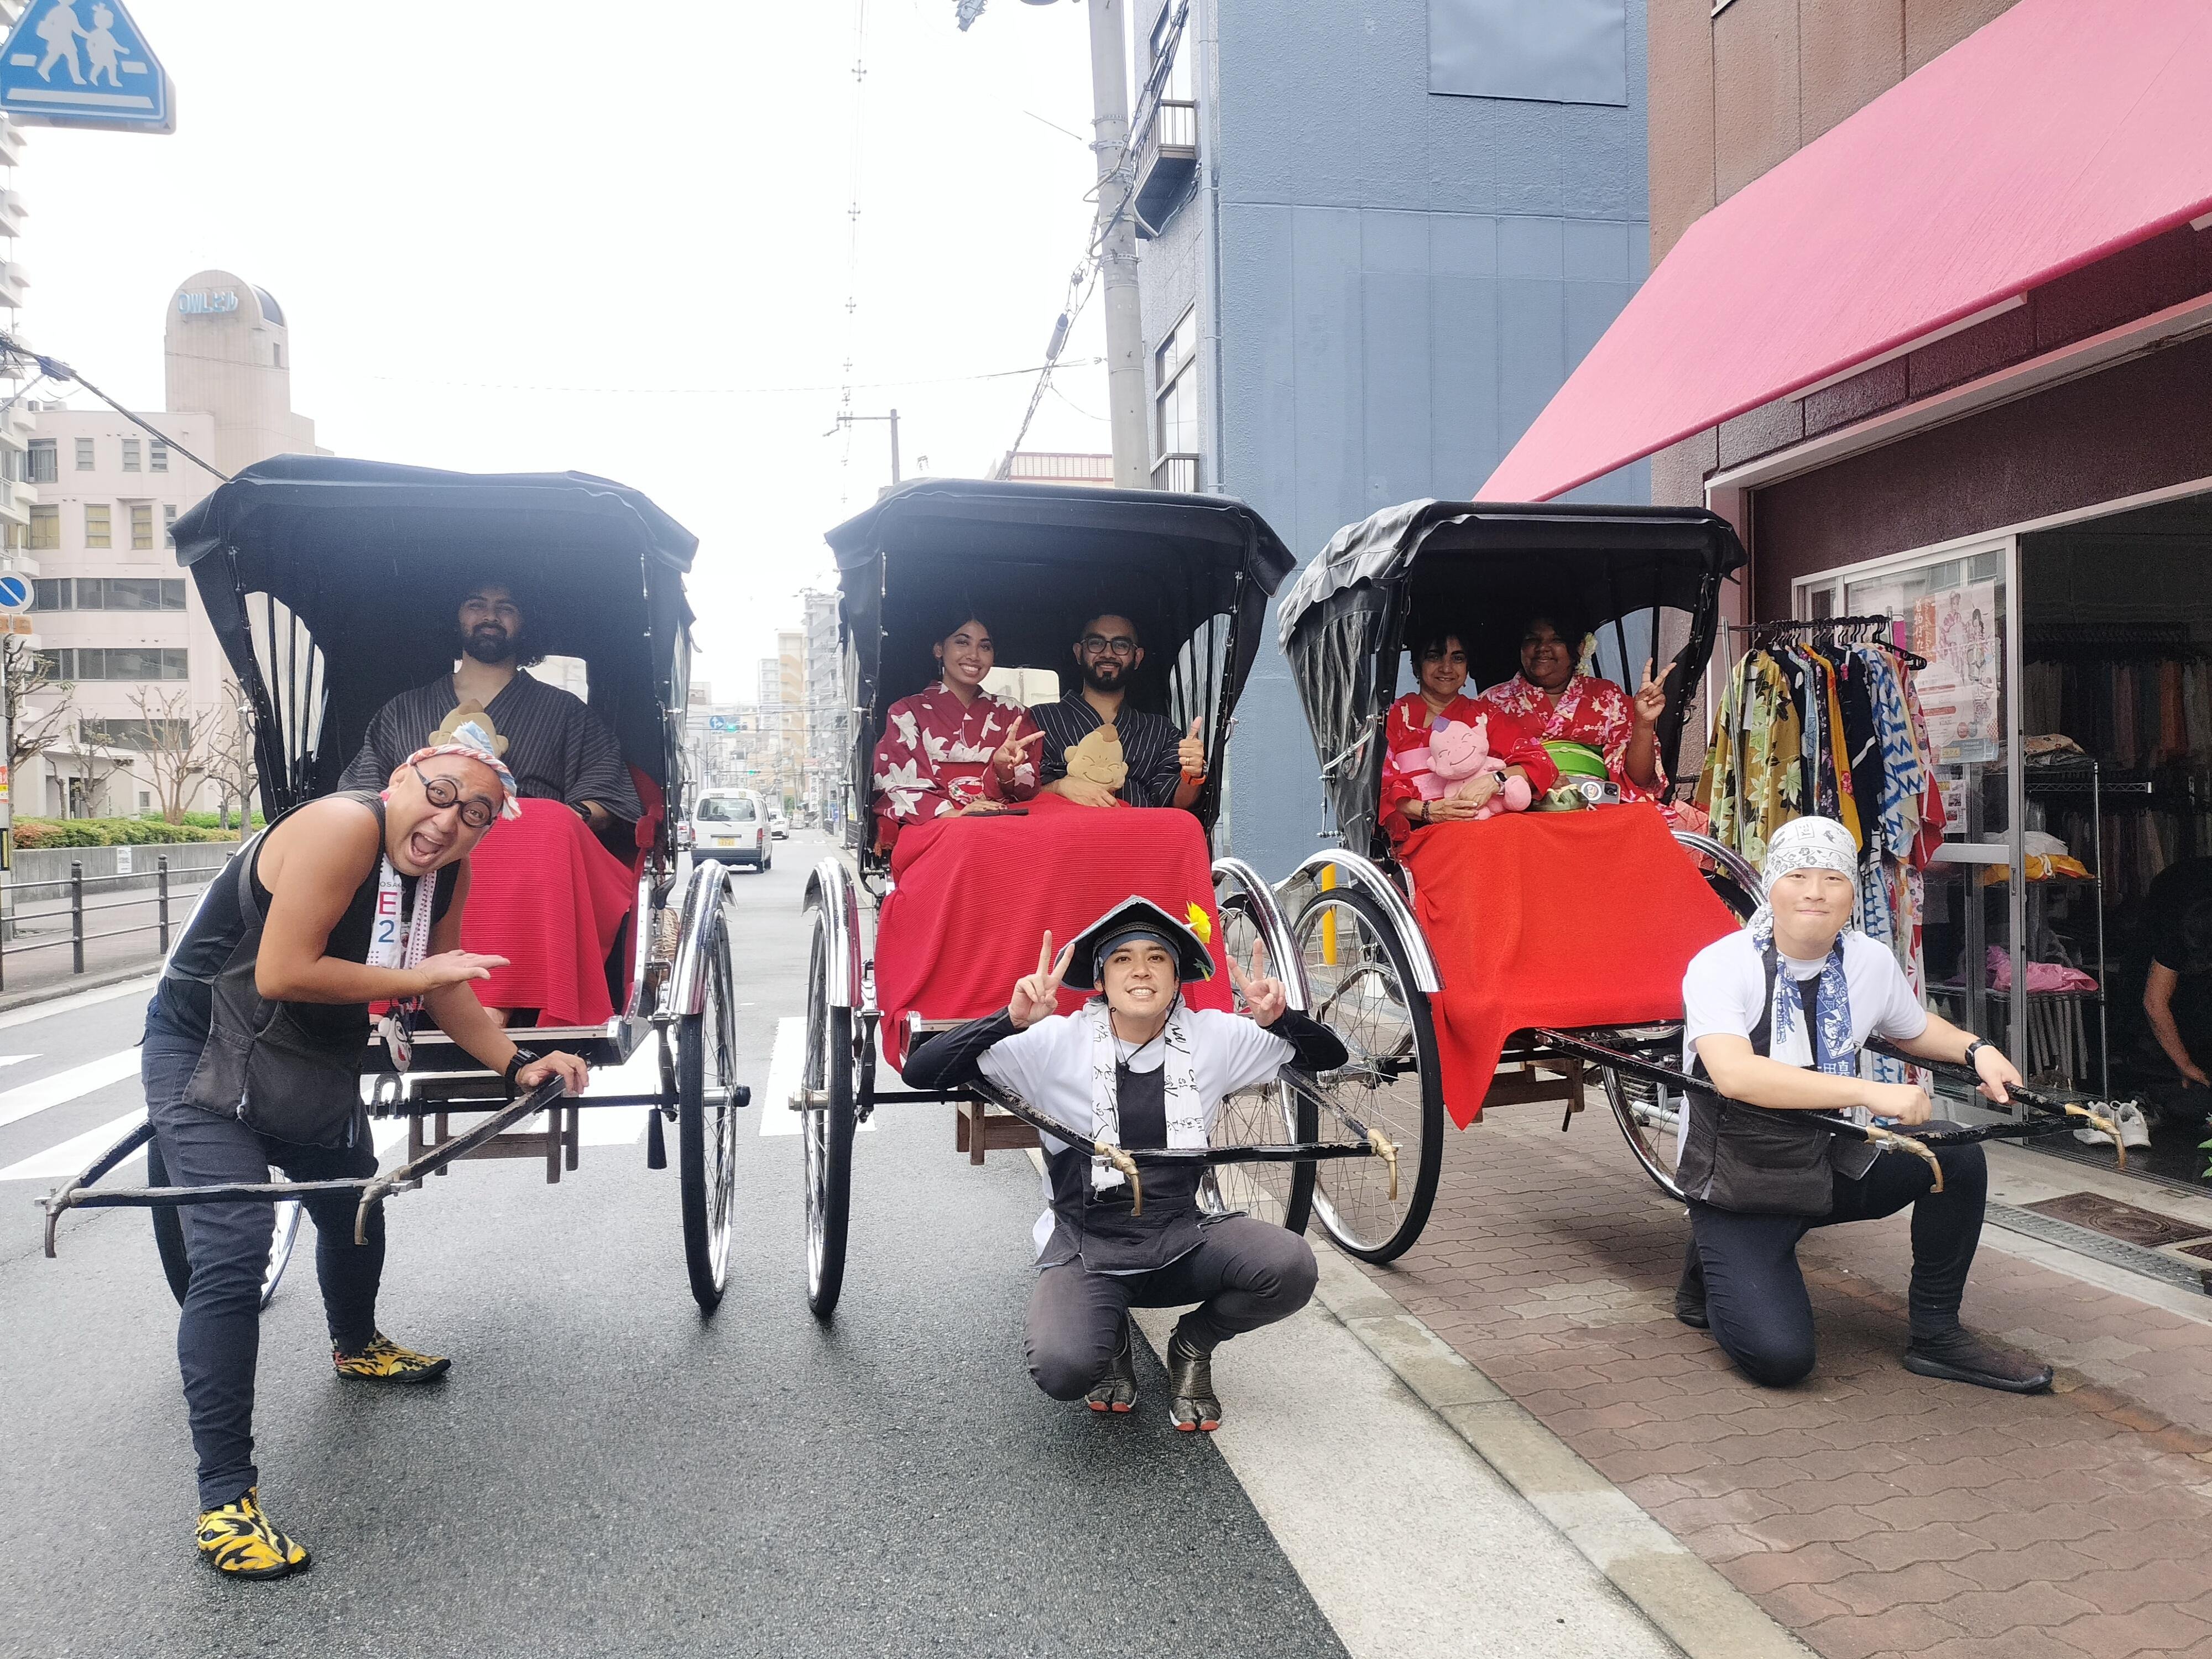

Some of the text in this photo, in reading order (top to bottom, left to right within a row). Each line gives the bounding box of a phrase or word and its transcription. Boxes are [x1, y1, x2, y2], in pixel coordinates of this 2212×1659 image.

[178, 291, 238, 314] OWLビル
[379, 891, 398, 915] E
[378, 920, 394, 943] 2
